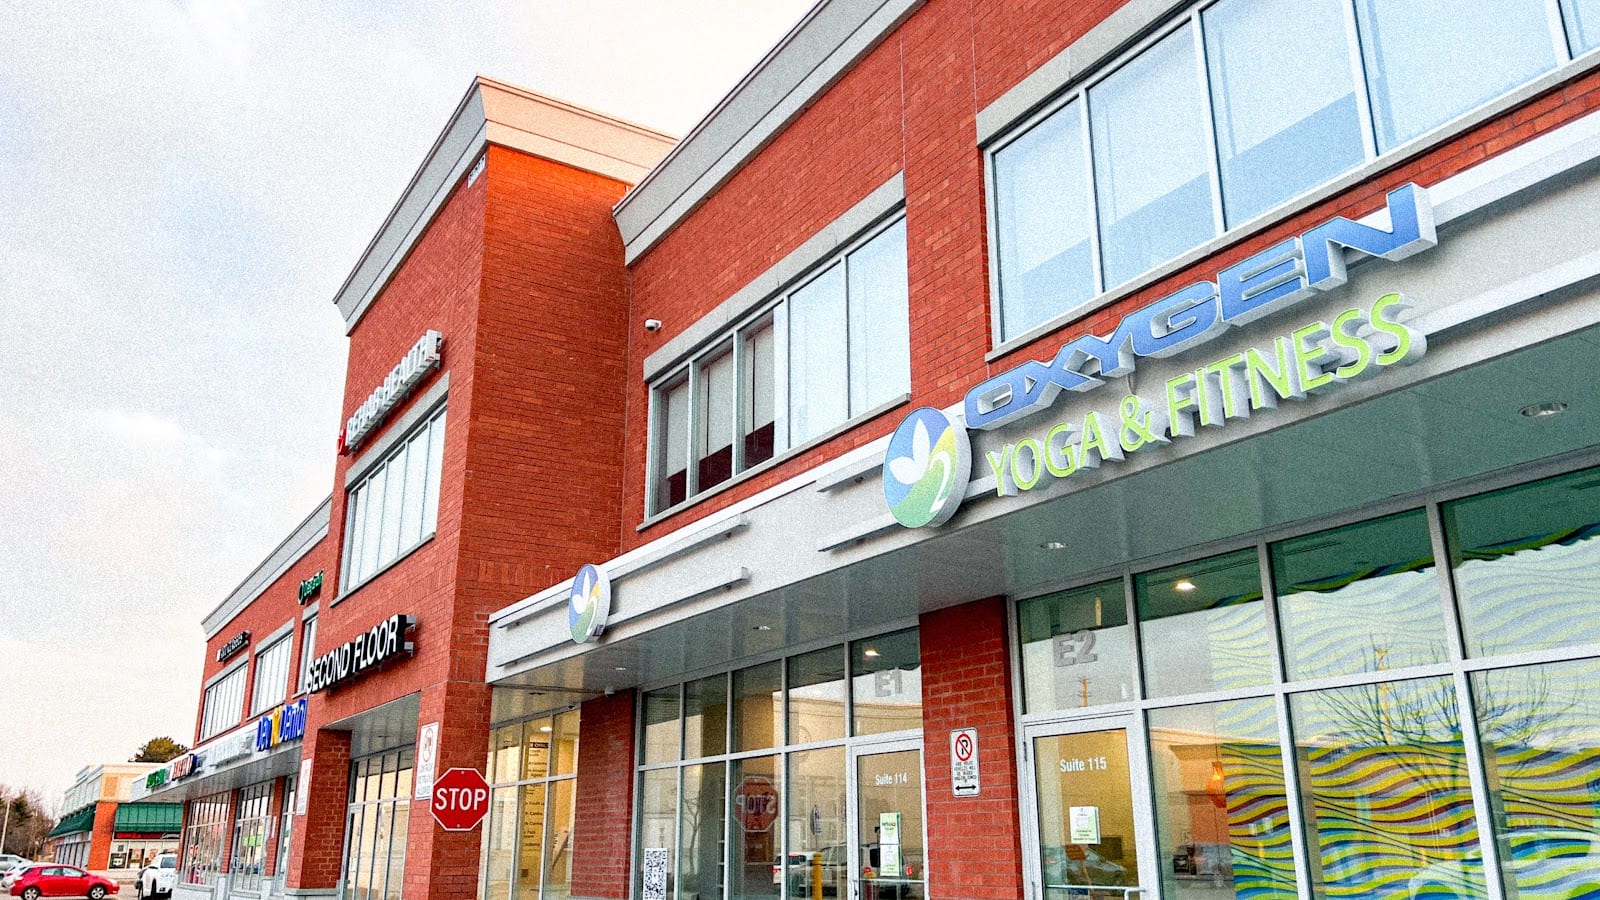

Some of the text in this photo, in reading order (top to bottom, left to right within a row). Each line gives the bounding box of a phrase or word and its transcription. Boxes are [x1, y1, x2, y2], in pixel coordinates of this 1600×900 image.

[964, 183, 1430, 430] OXYGEN
[383, 334, 430, 400] HEALTH
[985, 292, 1413, 498] YOGA & FITNESS
[306, 641, 352, 694] SECOND
[352, 614, 399, 674] FLOOR
[1052, 629, 1098, 667] E2
[874, 666, 903, 697] E1
[875, 771, 908, 785] Suite 114
[1060, 756, 1107, 772] Suite 115
[434, 787, 487, 811] STOP
